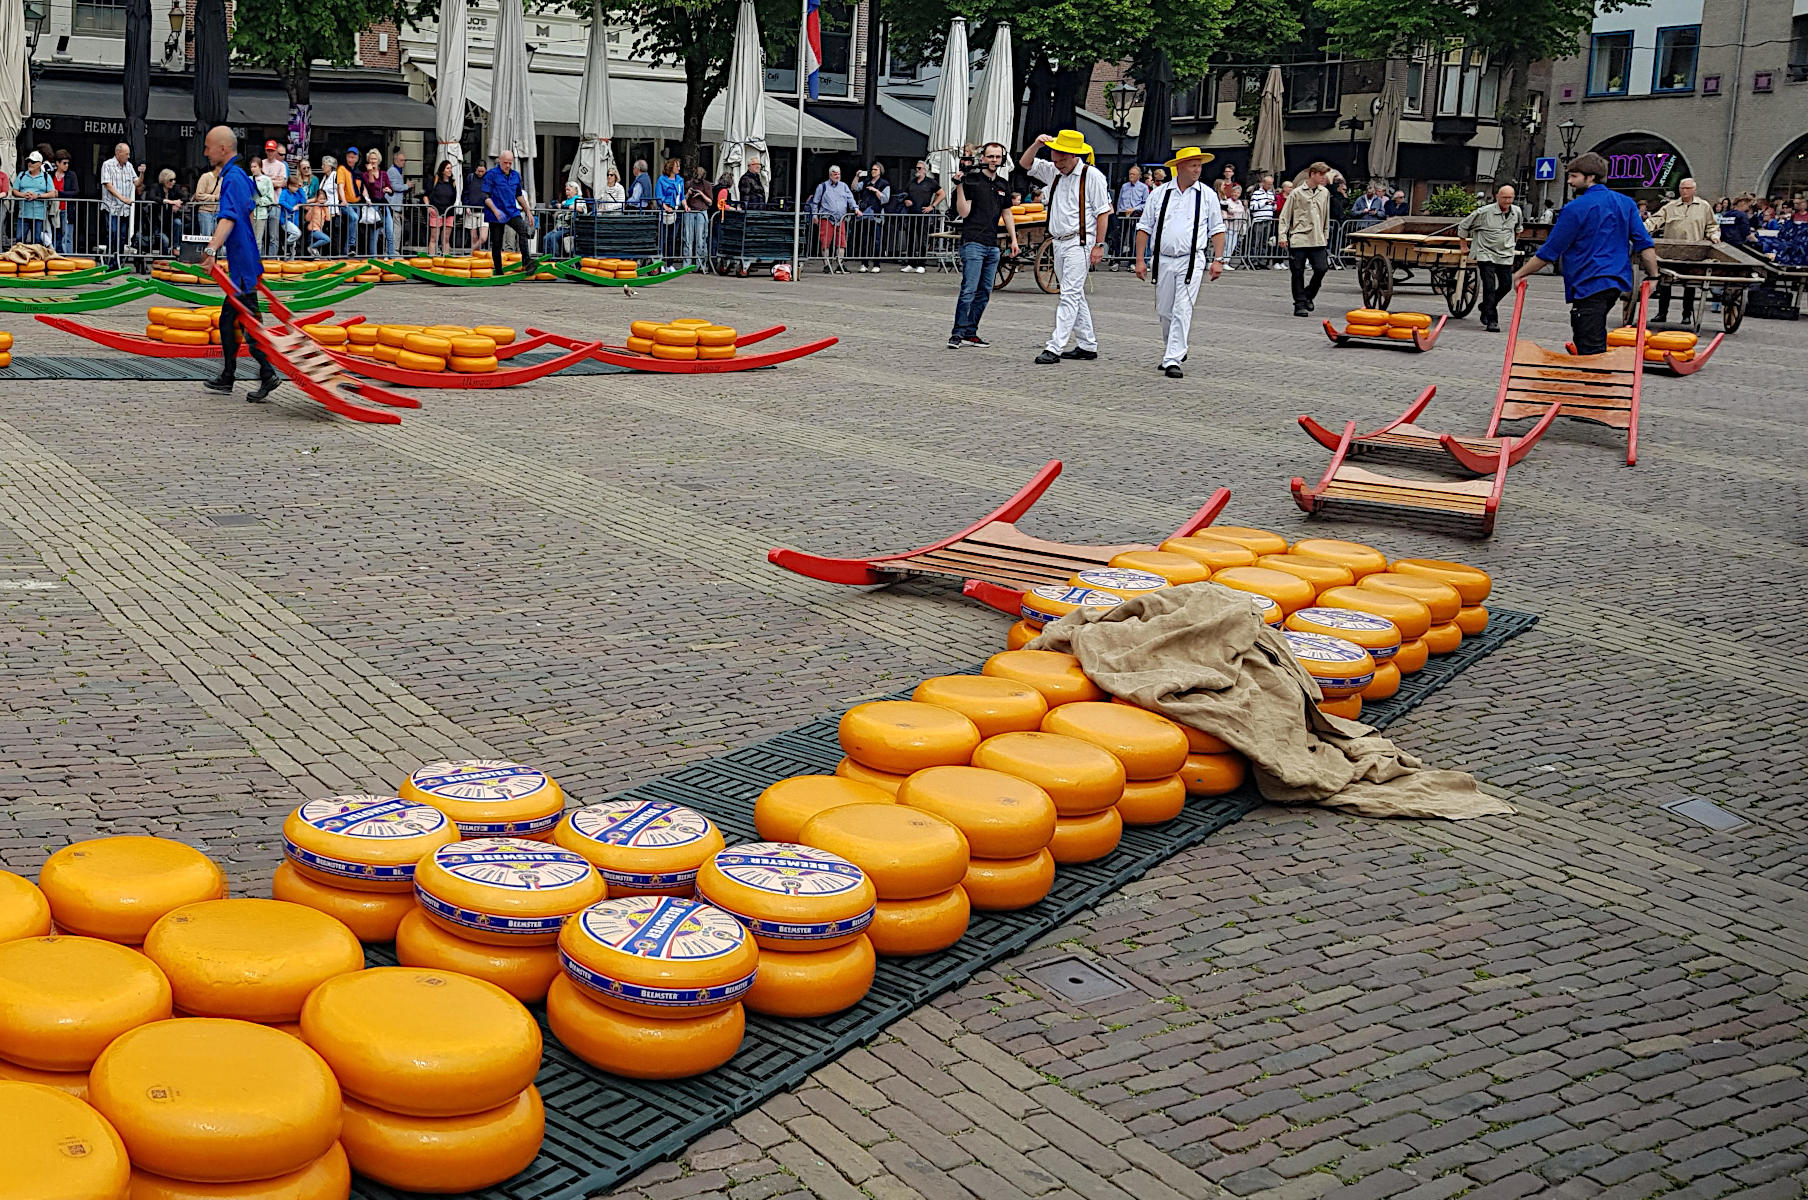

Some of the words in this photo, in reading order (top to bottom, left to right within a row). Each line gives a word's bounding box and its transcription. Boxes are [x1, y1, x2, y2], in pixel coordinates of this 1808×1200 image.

[1608, 153, 1670, 187] my
[444, 769, 513, 782] BEEMSTER
[619, 809, 663, 831] BEEMSTER
[472, 853, 555, 861] BEEMSTER
[750, 858, 830, 870] BEEMSTER
[508, 920, 543, 928] BEEMSTER
[645, 906, 686, 939] BEEMSTER
[569, 961, 592, 980] BEEMSTER
[725, 981, 748, 994] BEEMSTER
[641, 990, 678, 999] BEEMSTER
